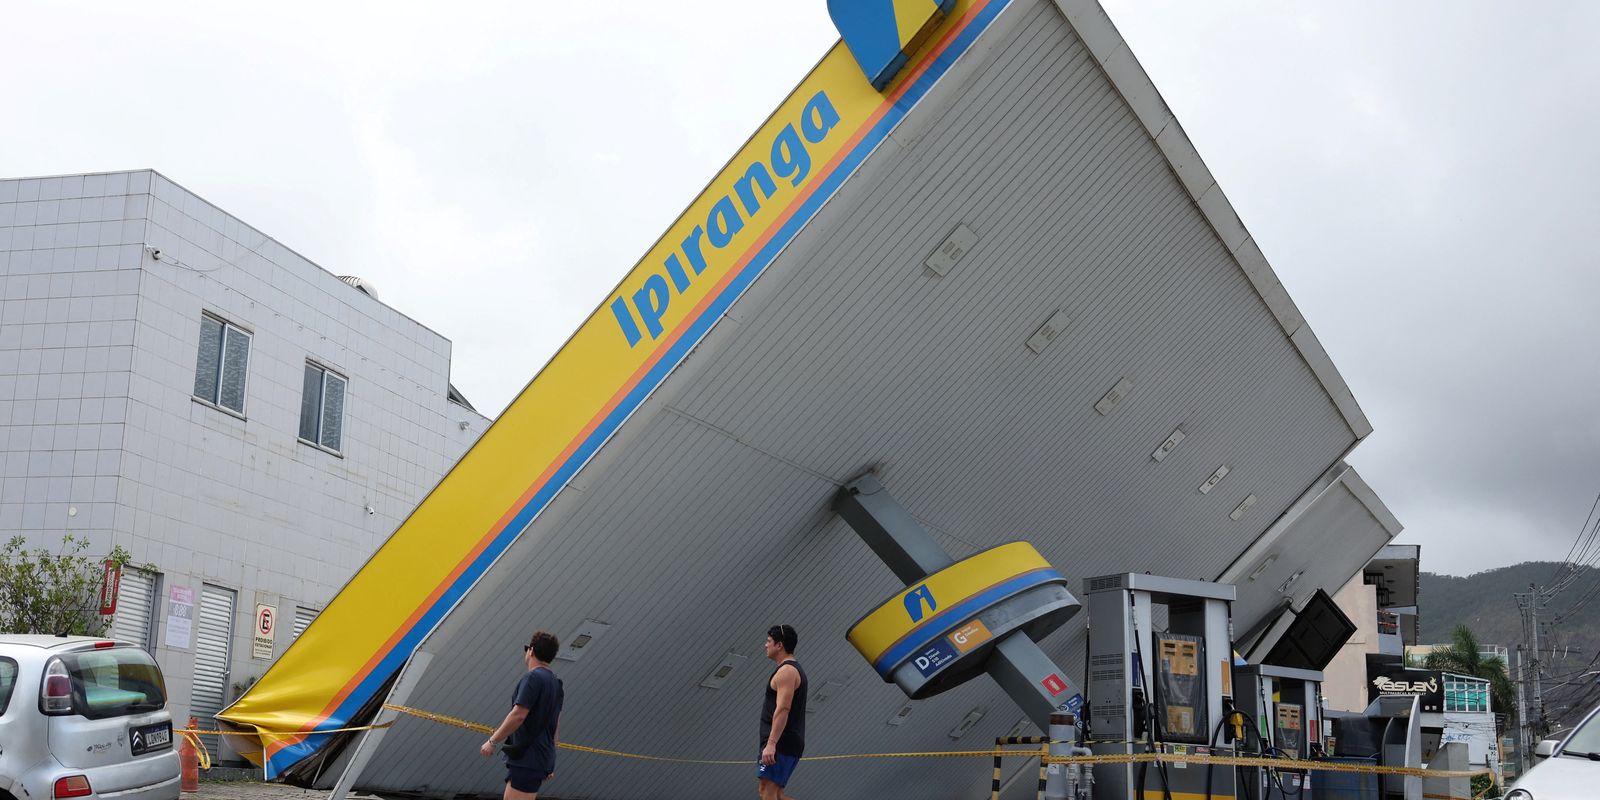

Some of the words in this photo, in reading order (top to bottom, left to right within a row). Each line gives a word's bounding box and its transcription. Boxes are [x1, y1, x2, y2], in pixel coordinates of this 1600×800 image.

[610, 90, 841, 349] Ipiranga
[954, 632, 967, 644] G
[914, 656, 930, 671] D
